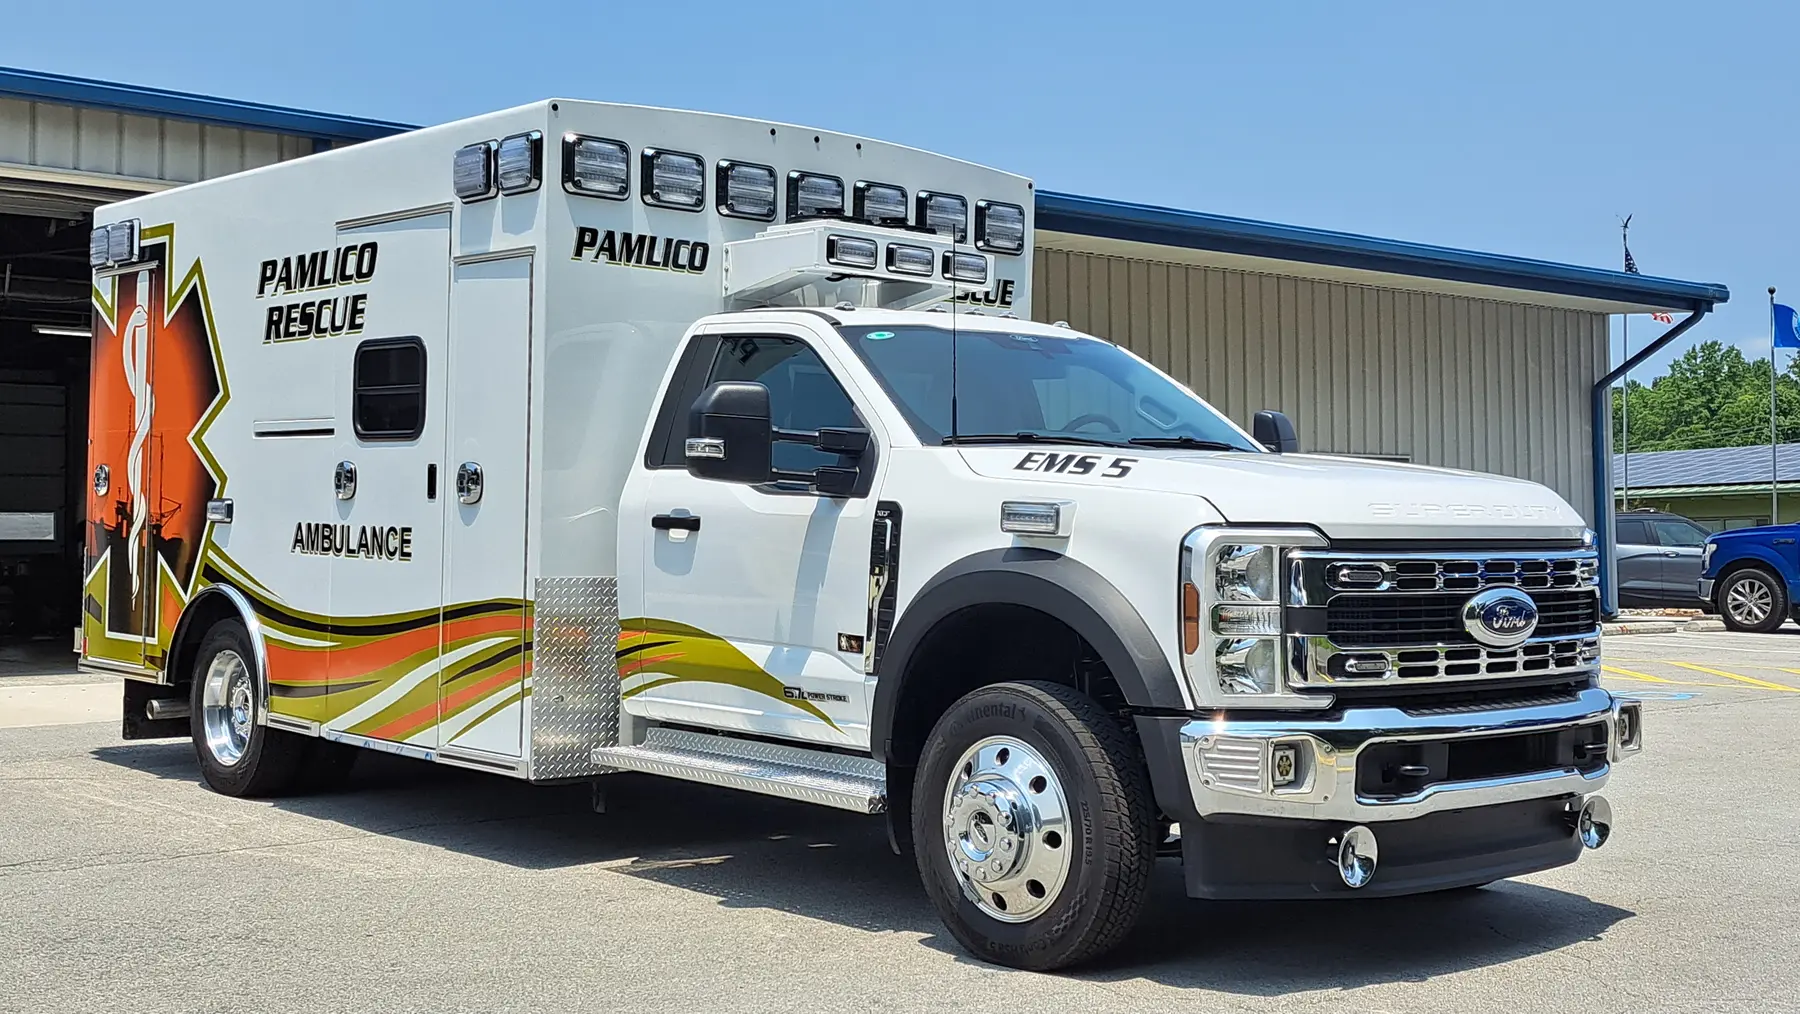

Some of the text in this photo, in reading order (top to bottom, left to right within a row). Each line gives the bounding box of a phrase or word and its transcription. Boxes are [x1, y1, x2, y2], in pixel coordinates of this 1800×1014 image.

[255, 241, 378, 298] PAMLICO
[570, 226, 709, 275] PAMLICO
[262, 293, 367, 344] RESCUE
[1012, 452, 1139, 478] EMS 5
[291, 521, 412, 561] AMBULANCE
[1493, 604, 1526, 629] Ford
[783, 686, 848, 703] 6.7L POWER STROKE
